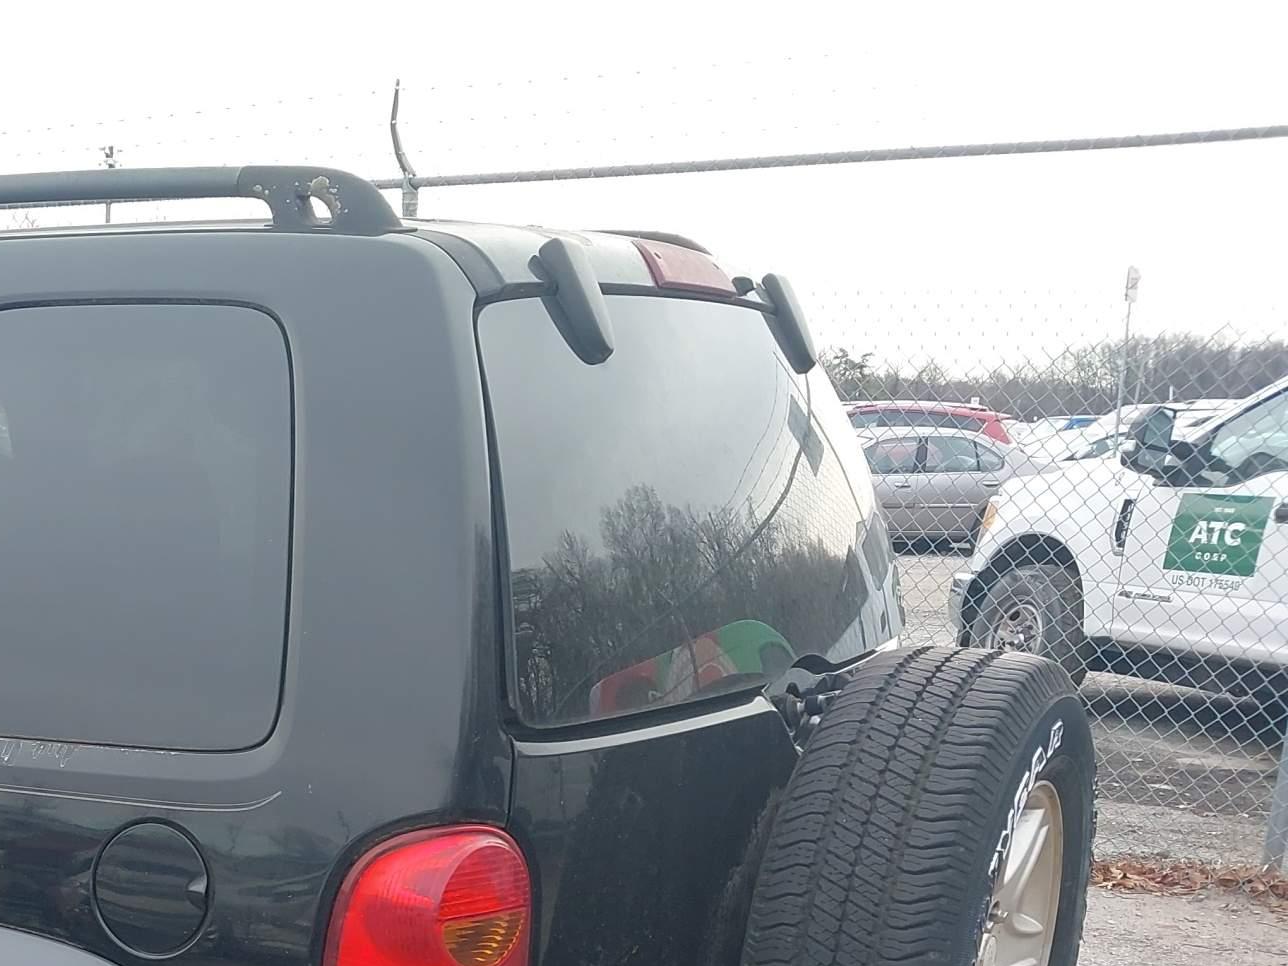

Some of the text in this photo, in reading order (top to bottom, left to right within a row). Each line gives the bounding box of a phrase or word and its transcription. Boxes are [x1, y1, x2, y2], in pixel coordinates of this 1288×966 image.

[1188, 520, 1247, 546] ATC
[1171, 574, 1184, 586] US
[1186, 576, 1208, 588] DOT
